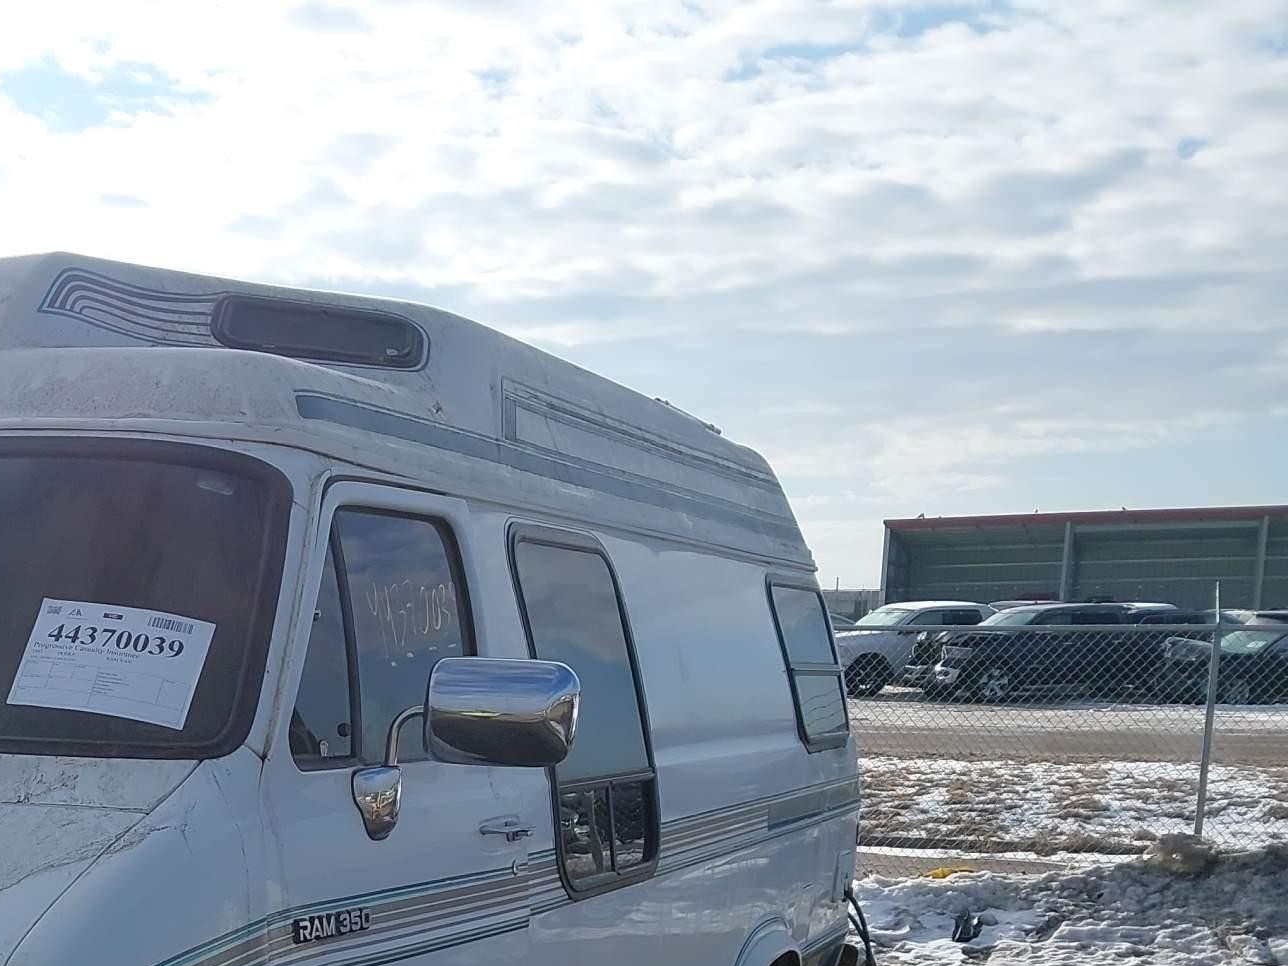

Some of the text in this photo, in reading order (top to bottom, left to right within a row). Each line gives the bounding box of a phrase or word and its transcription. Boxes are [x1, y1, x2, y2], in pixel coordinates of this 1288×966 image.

[47, 623, 185, 659] 44370039
[299, 908, 372, 941] RAM 350
